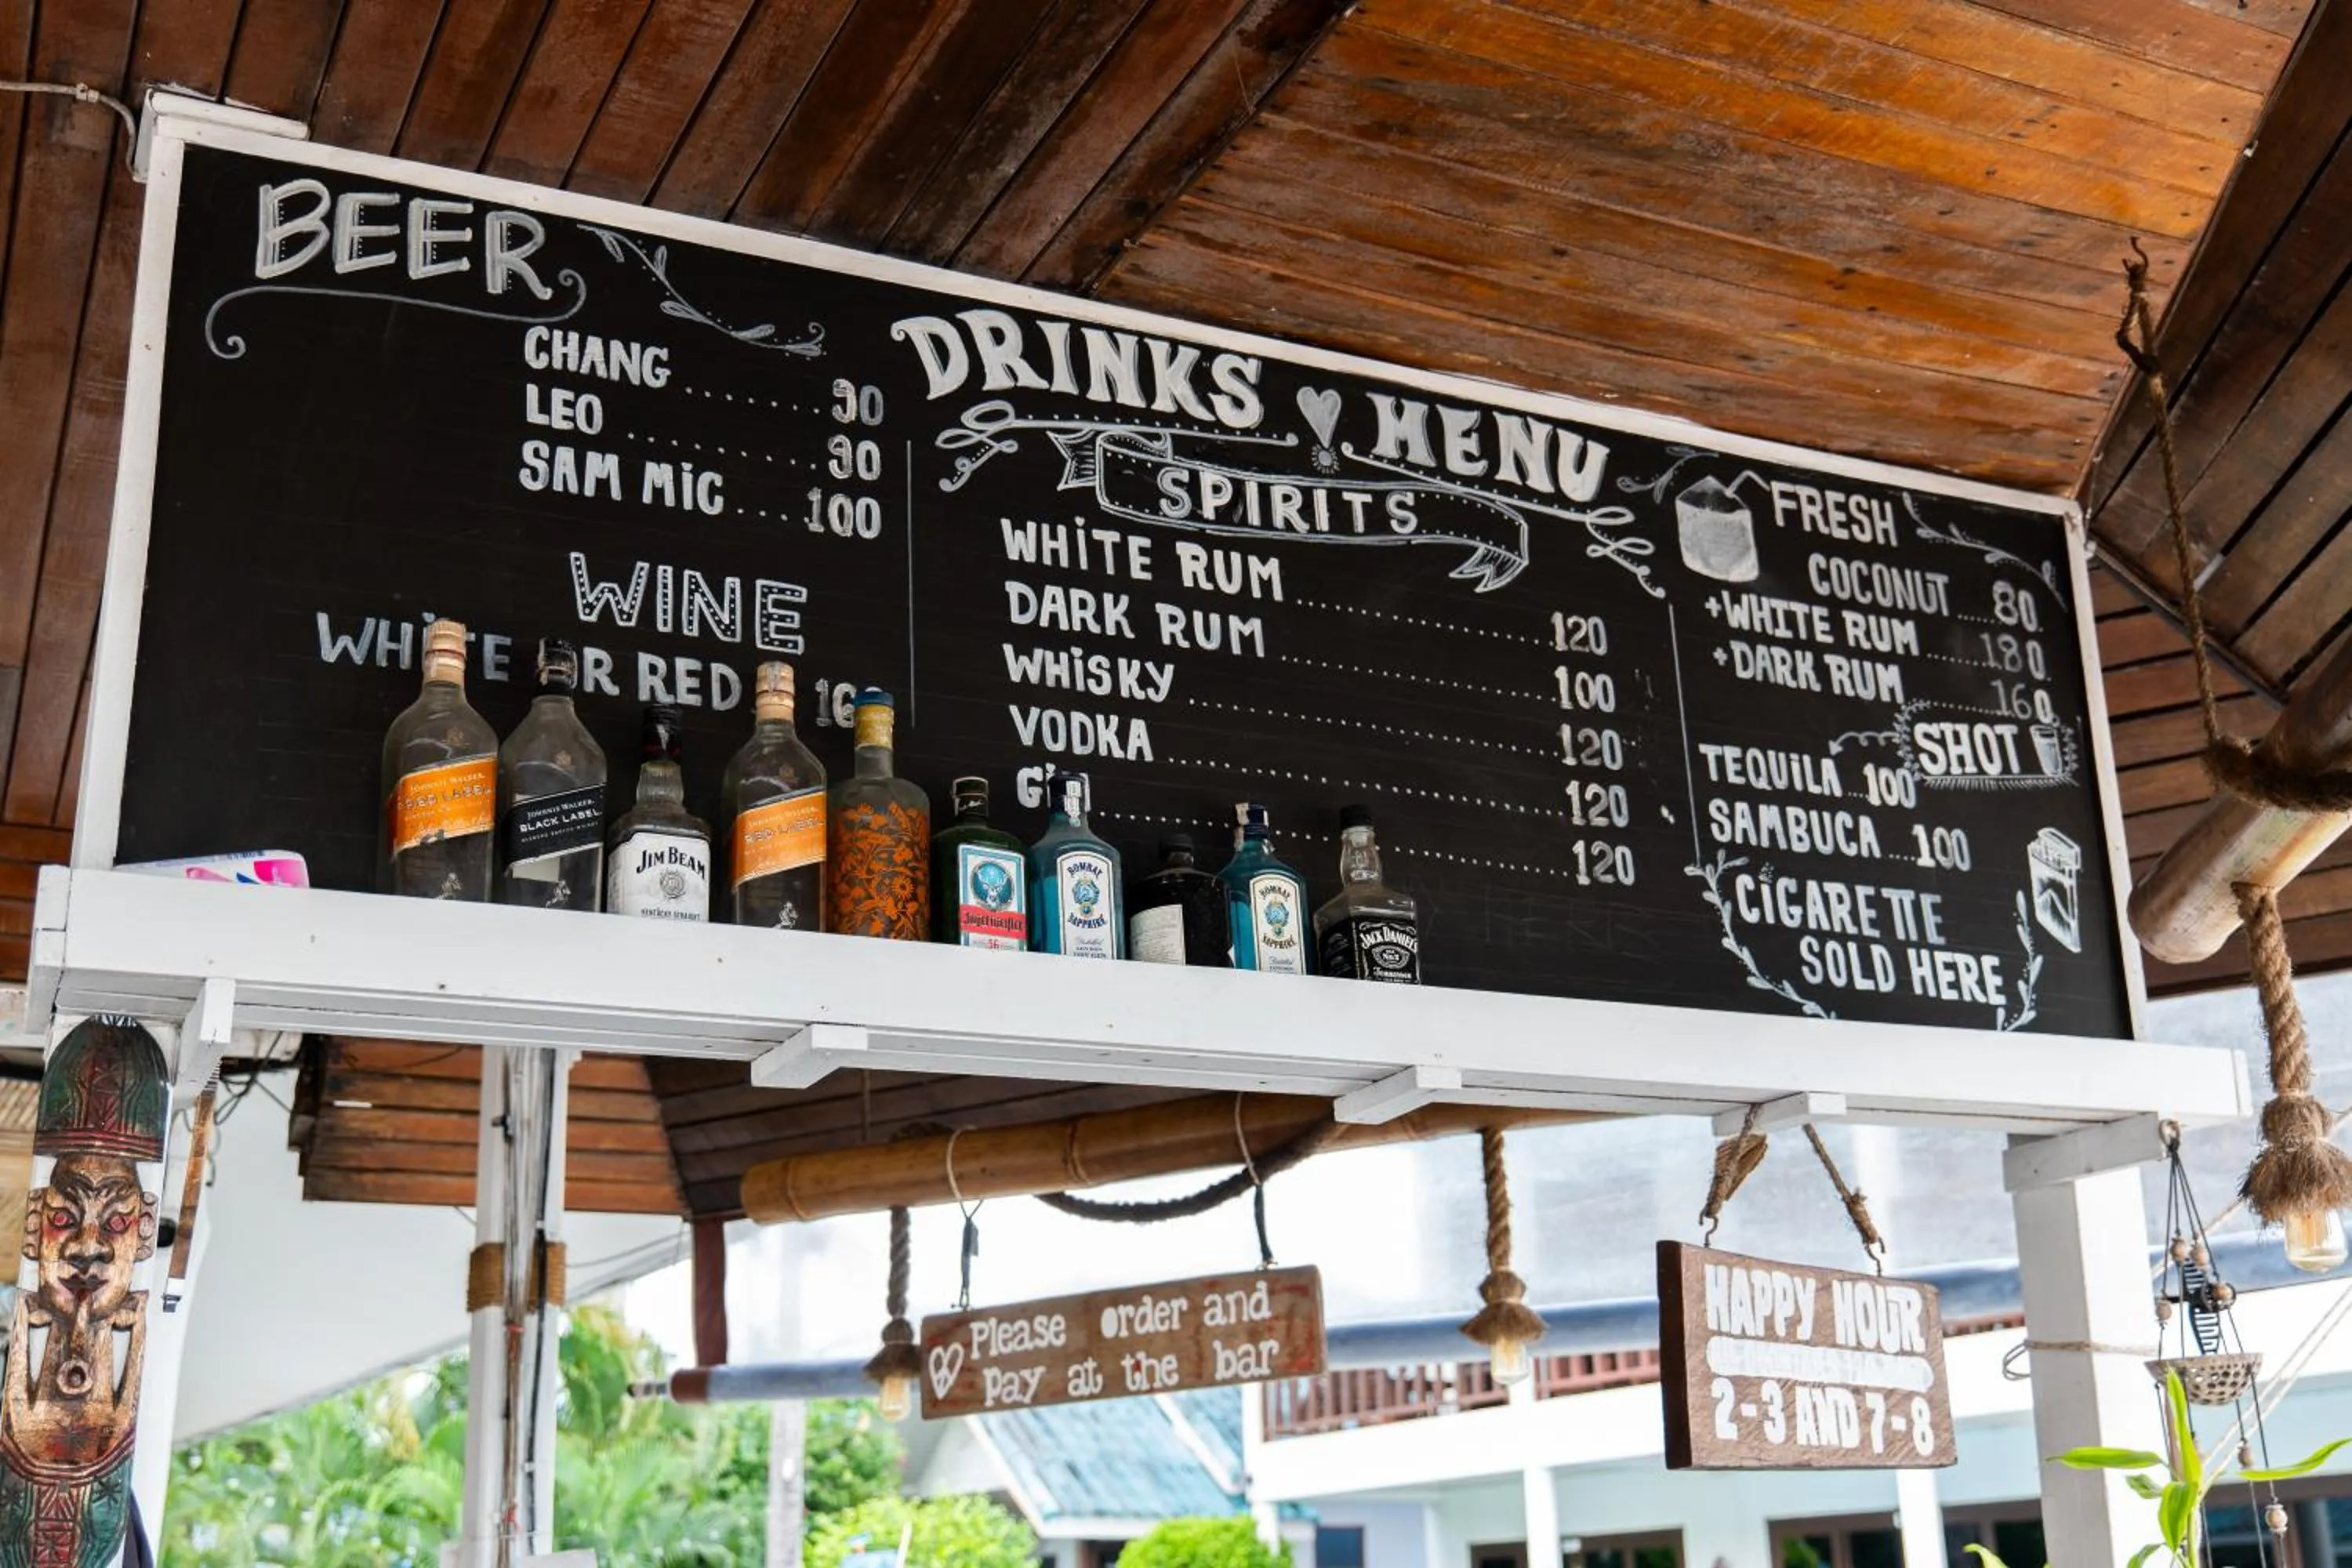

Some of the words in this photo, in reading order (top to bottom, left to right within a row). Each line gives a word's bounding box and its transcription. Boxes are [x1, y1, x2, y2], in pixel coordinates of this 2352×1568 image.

[256, 179, 554, 300] BEER
[524, 325, 672, 388] CHANG
[526, 383, 603, 435] LEO
[828, 434, 881, 481] 90
[891, 308, 1265, 430] DRINKS
[1365, 390, 1611, 503] MENU
[519, 440, 622, 501] SAM
[806, 487, 882, 539] 100
[1157, 466, 1418, 534] SPIRITS
[1770, 481, 1898, 547] FRESH
[569, 551, 808, 655] WINE
[1175, 541, 1284, 601] RUM
[1551, 612, 1608, 656] 120
[1808, 553, 1949, 617] COCONUT
[317, 612, 512, 681] WHE
[637, 652, 741, 711] RED
[1004, 580, 1136, 639] DARK
[1155, 602, 1265, 658] RUM
[1554, 665, 1616, 713] 100
[1841, 609, 1919, 656] RUM
[1823, 653, 1905, 705] RUM
[1008, 704, 1154, 762] VODKA
[1565, 779, 1629, 828] 120
[1560, 723, 1623, 771] 120
[1913, 721, 2021, 776] SHOT
[1863, 762, 1917, 809] 100
[519, 816, 559, 832] BLACK
[1708, 797, 1882, 859] SAMBUCA
[1911, 823, 1971, 873] 100
[636, 849, 665, 874] JIM
[668, 846, 706, 880] BEAM
[1572, 840, 1635, 886] 120
[1799, 935, 1896, 993] SOLD
[1906, 947, 2008, 1006] HERE
[969, 1313, 1067, 1360] Please
[1203, 1280, 1272, 1327] and
[1704, 1263, 1816, 1341] HAPPY
[1832, 1279, 1926, 1354] HOUR
[982, 1364, 1047, 1407] pay
[1067, 1356, 1104, 1397] at
[1121, 1349, 1180, 1392] the
[1213, 1338, 1280, 1381] bar
[1795, 1385, 1860, 1449] AND
